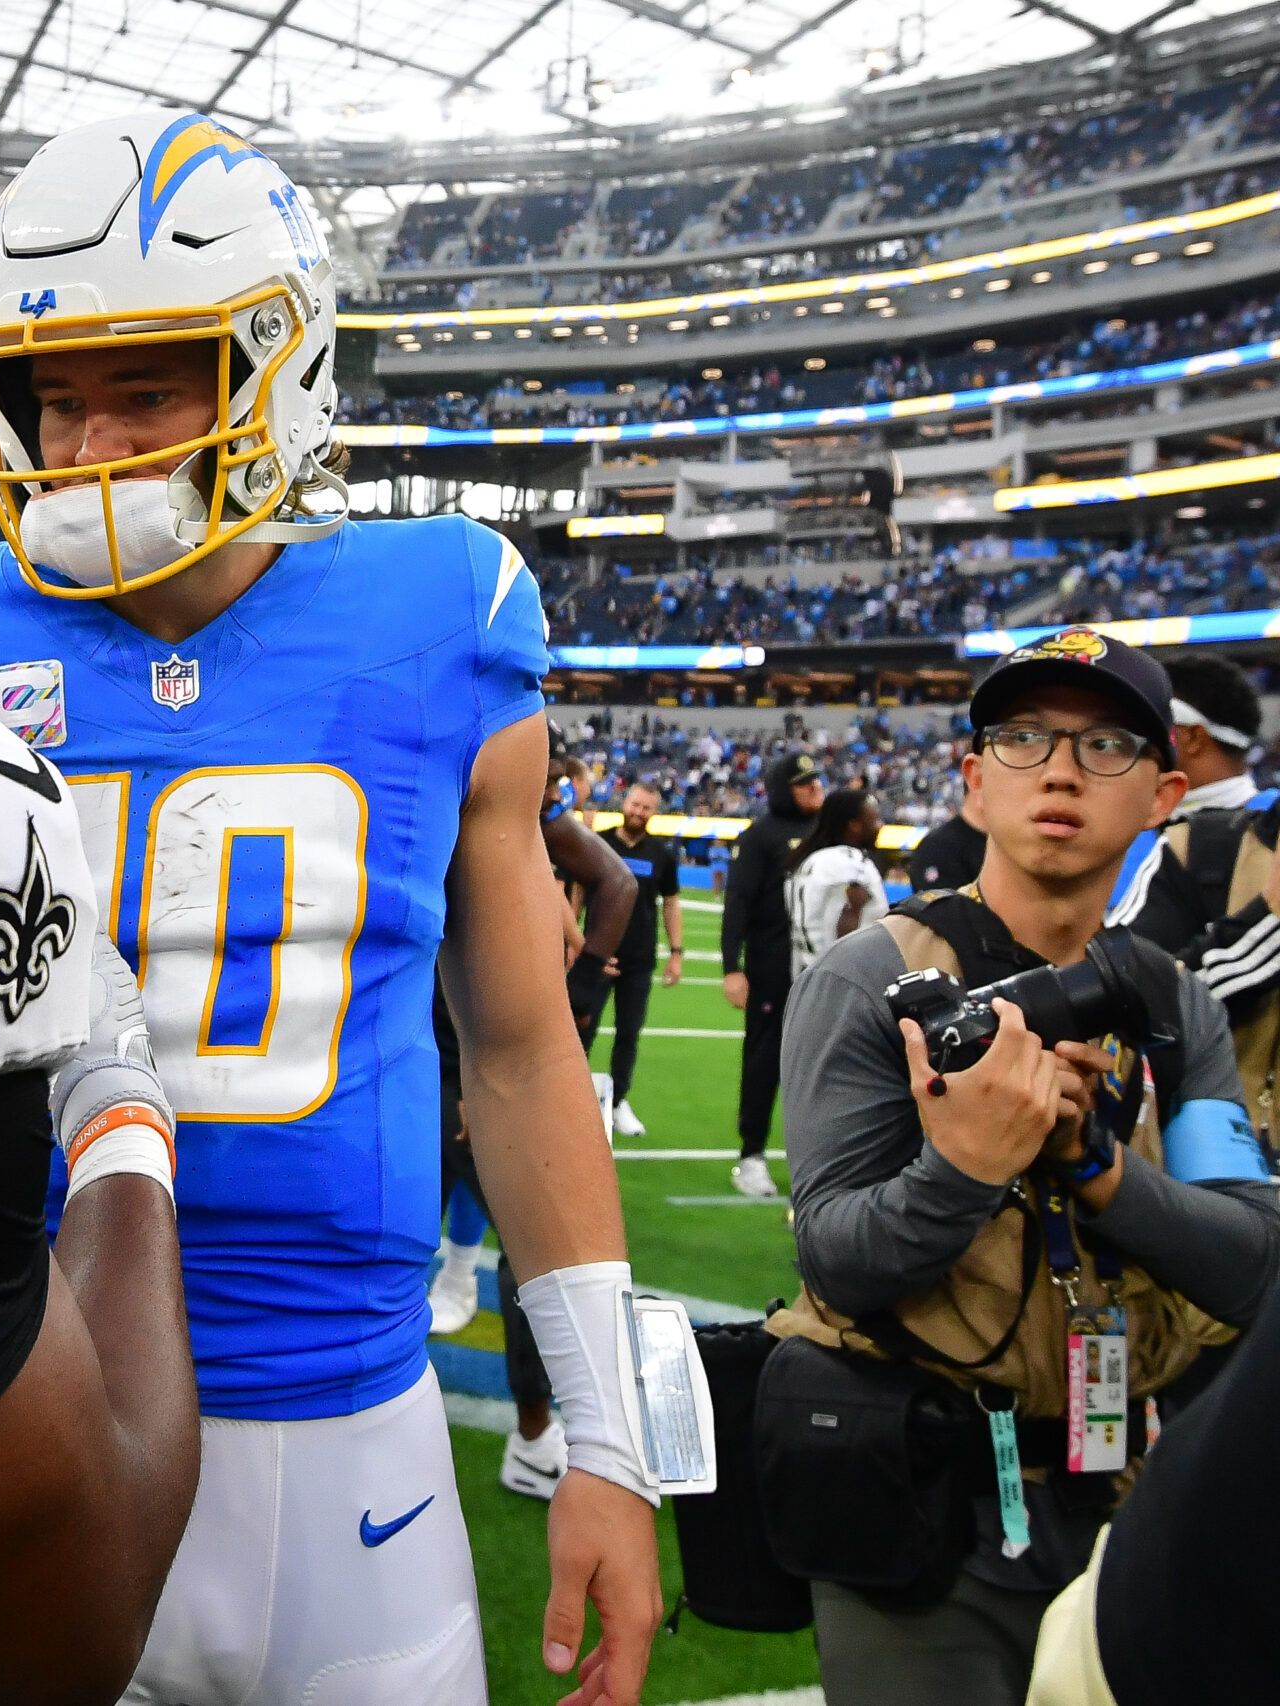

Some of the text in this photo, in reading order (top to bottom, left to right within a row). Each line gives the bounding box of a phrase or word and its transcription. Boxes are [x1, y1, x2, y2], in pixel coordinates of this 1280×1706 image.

[268, 184, 321, 273] 10
[19, 289, 56, 319] LA
[160, 679, 191, 700] NFL
[75, 1117, 108, 1149] SAINTS
[1070, 1347, 1083, 1458] MEDIA
